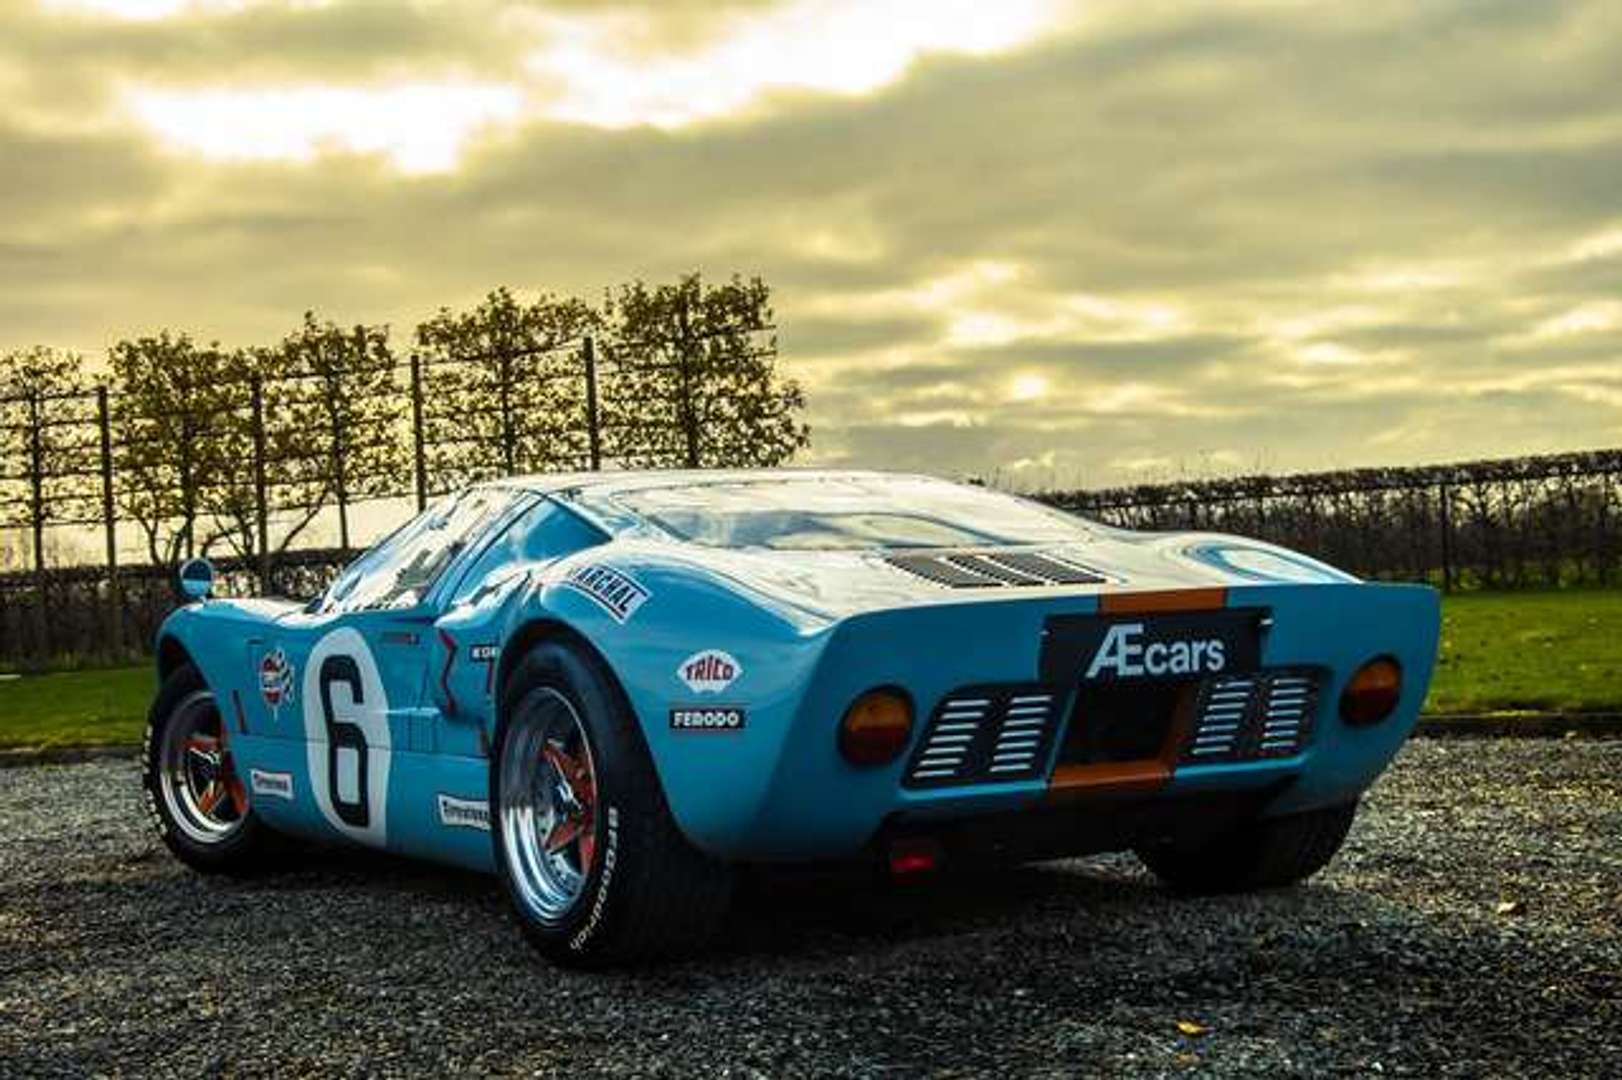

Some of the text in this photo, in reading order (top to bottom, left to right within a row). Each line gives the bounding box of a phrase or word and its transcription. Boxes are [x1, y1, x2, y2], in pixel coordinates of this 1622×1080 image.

[684, 654, 734, 682] TRICO
[1085, 622, 1226, 679] Æcars
[319, 653, 370, 827] 6
